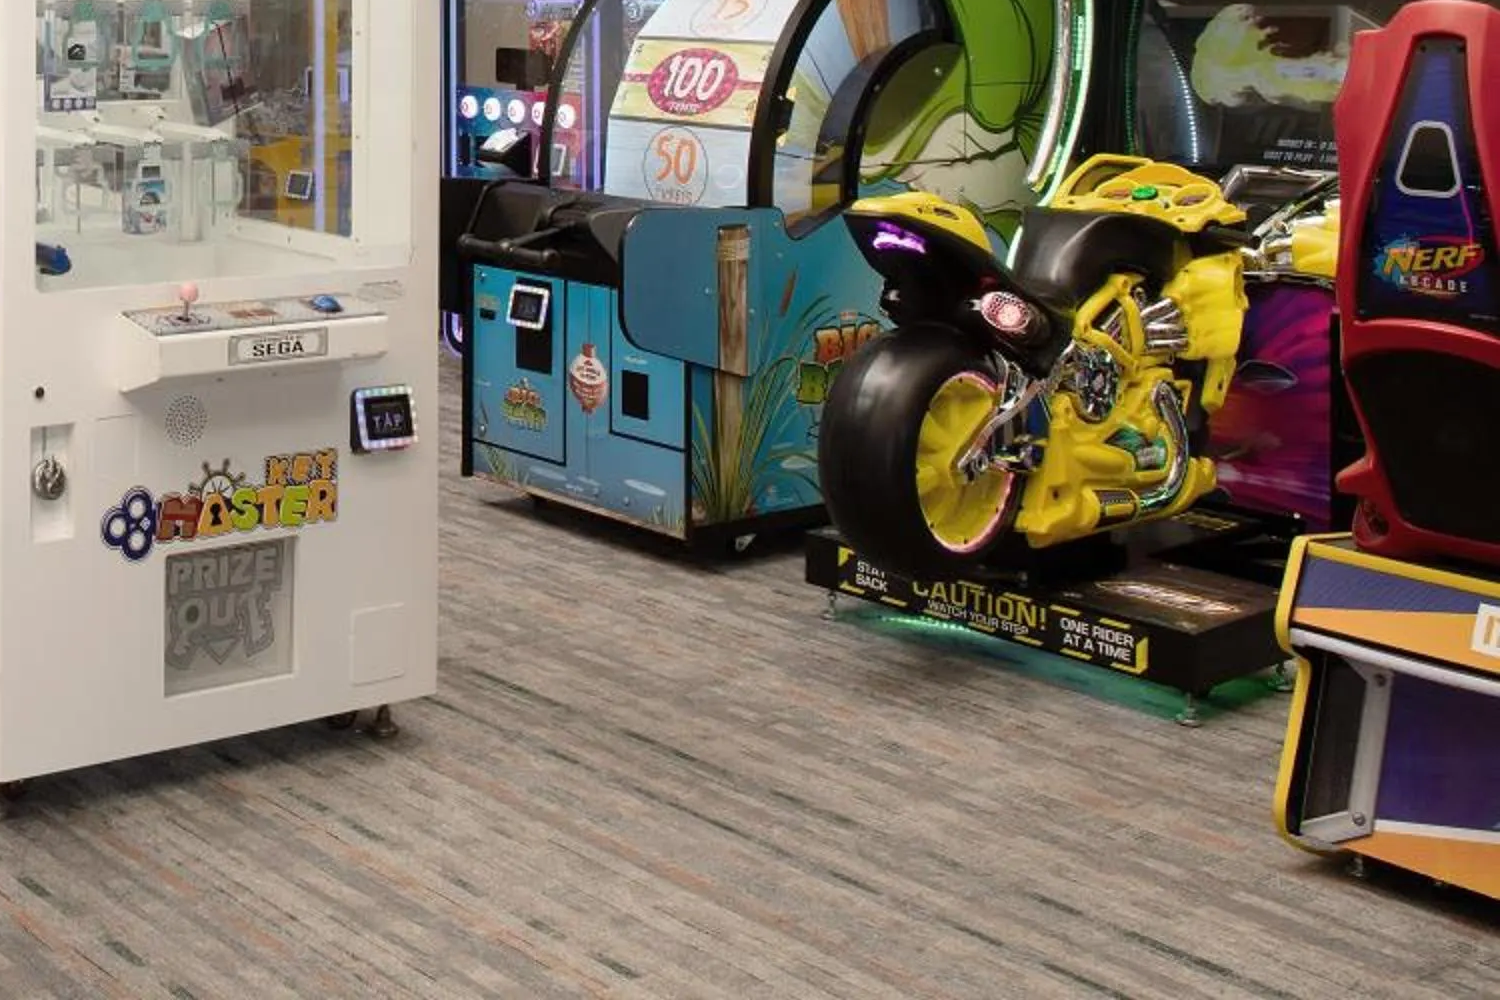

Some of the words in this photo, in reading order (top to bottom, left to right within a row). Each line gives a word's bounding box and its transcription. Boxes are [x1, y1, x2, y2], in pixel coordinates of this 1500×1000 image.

[662, 54, 725, 101] 100
[655, 133, 697, 185] 50
[1384, 244, 1482, 275] NERF
[252, 340, 304, 357] SEGA
[372, 413, 404, 431] TAP
[265, 449, 337, 486] KEY
[156, 480, 338, 543] MASTER
[170, 548, 278, 595] PRIZE
[855, 574, 888, 593] BACK
[928, 600, 968, 619] WATCH
[970, 611, 999, 629] YOUR
[1001, 620, 1029, 636] STEP
[1060, 618, 1089, 636] ONE
[1092, 626, 1134, 649] RIDER
[1063, 633, 1081, 647] AT
[1083, 639, 1094, 652] A
[1097, 642, 1131, 662] TIME
